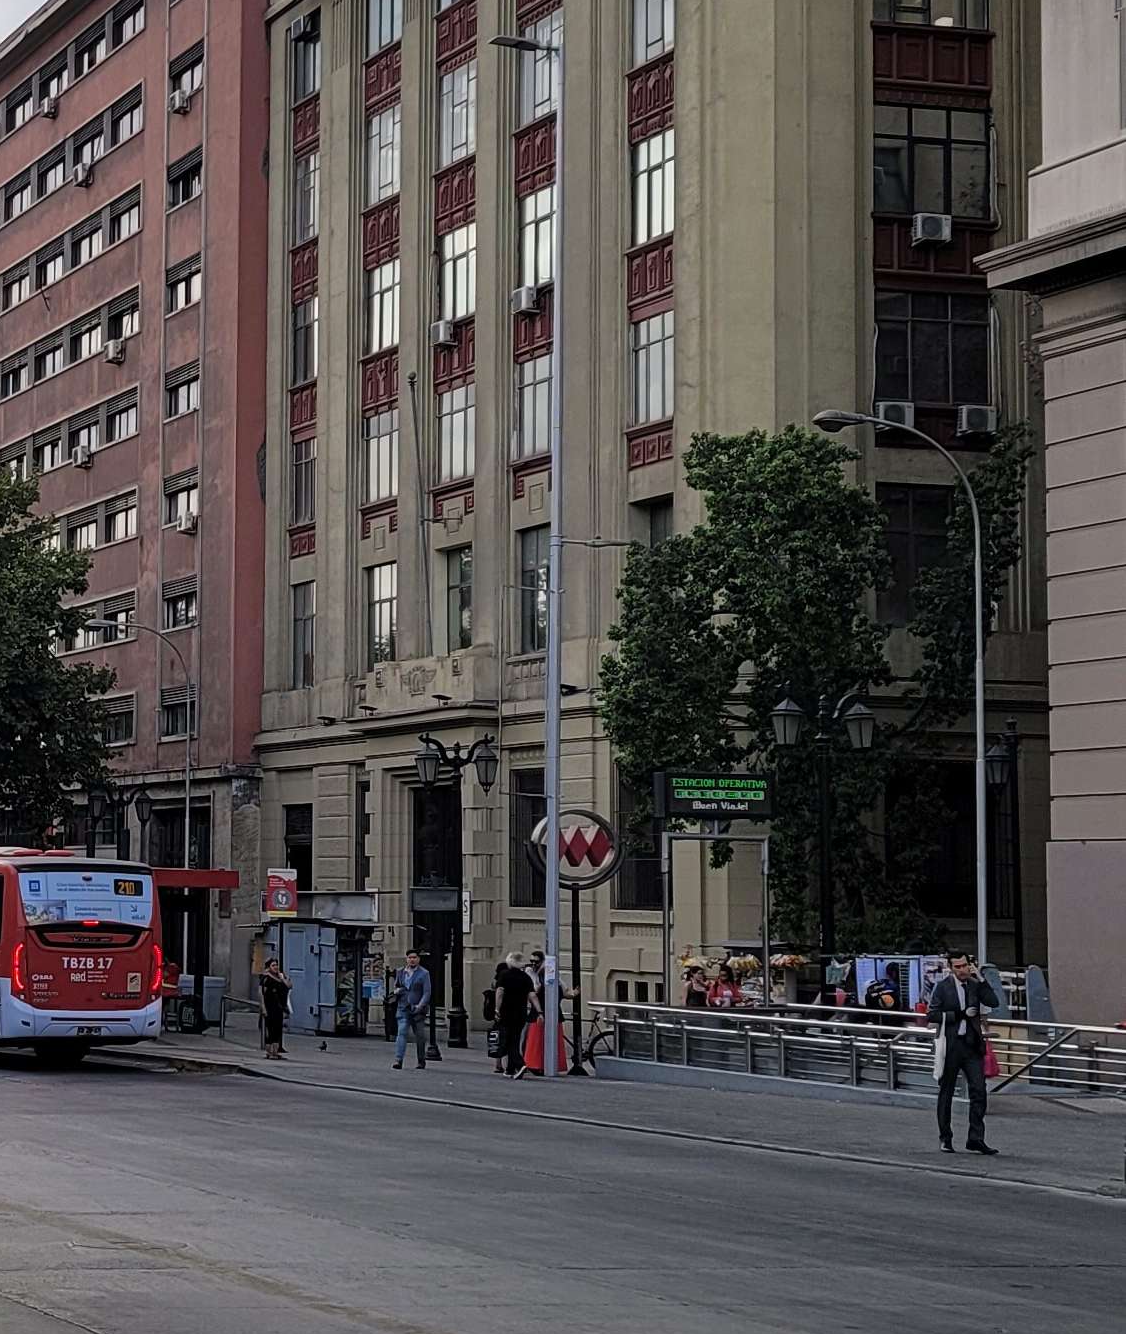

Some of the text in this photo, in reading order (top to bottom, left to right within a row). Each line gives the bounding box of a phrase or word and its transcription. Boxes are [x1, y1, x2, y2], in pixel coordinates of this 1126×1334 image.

[673, 778, 767, 789] ESTACION OPERATIVA
[118, 881, 134, 895] 210
[62, 957, 113, 969] TBZB 17
